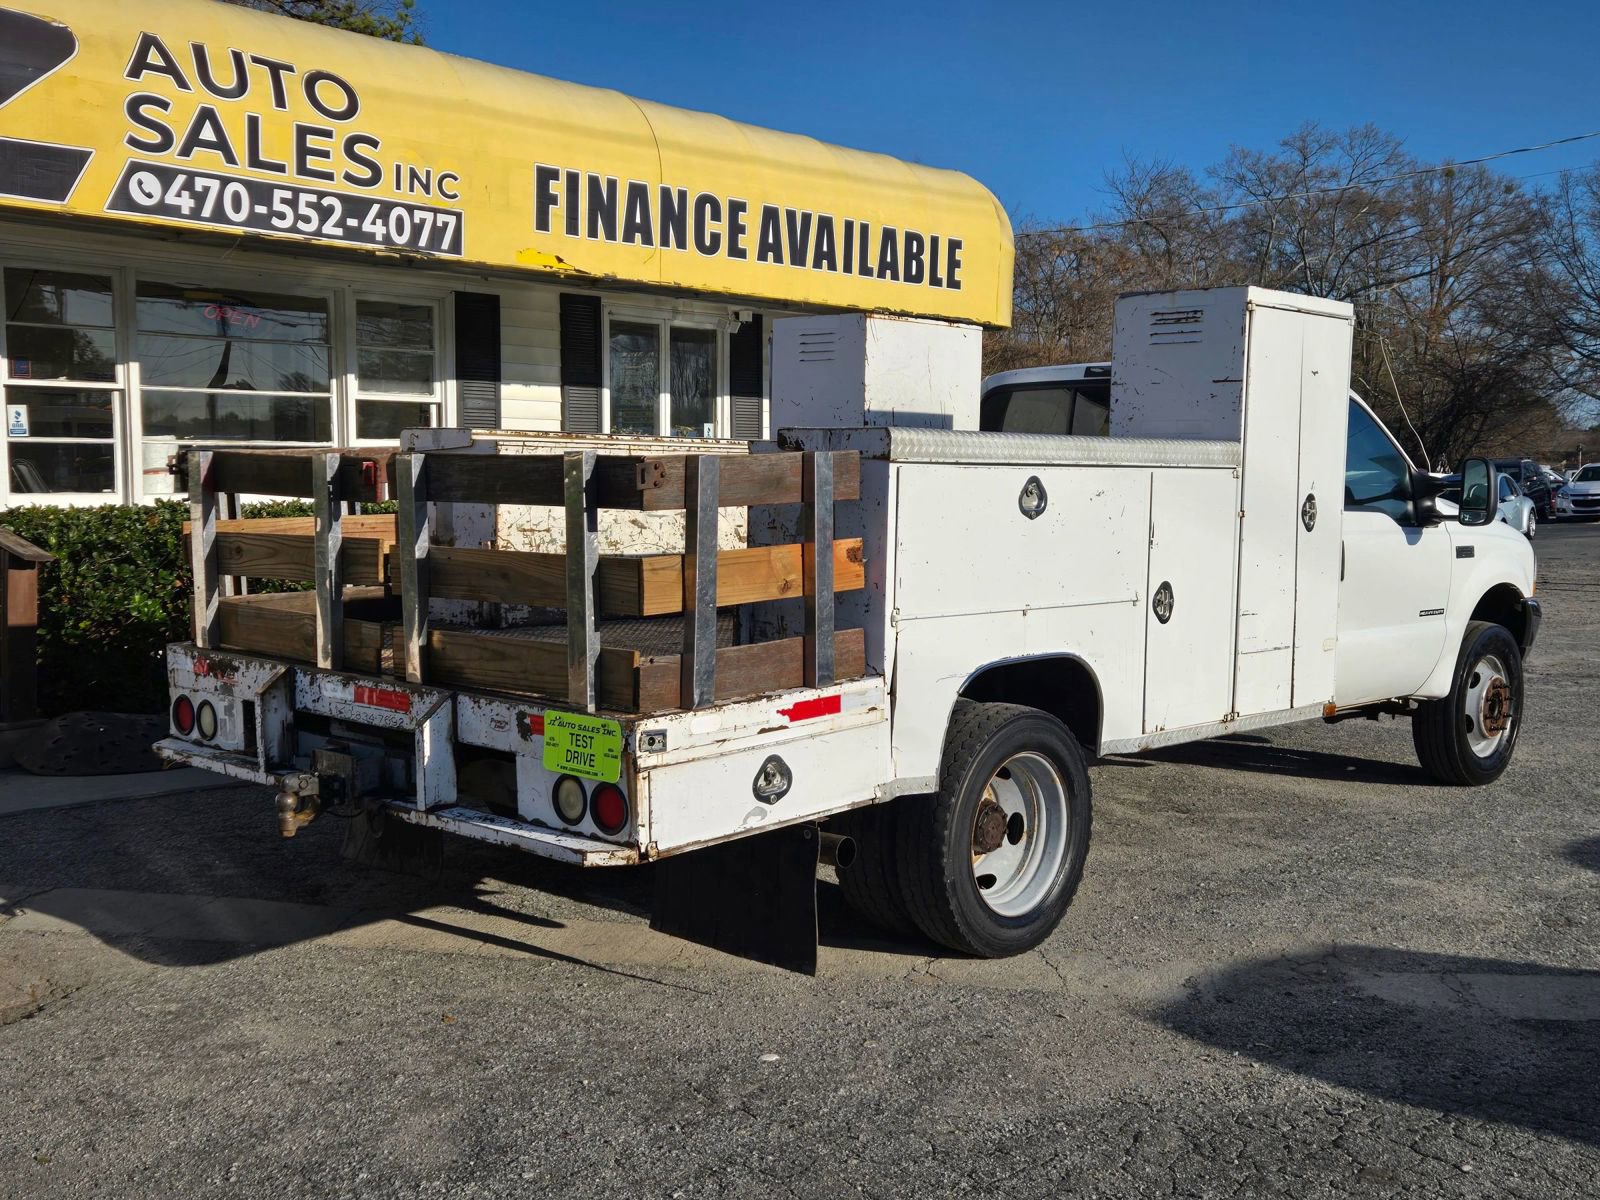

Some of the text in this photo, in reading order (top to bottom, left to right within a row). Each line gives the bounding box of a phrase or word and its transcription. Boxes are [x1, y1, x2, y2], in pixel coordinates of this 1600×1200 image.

[124, 31, 361, 123] AUTO
[124, 92, 461, 201] SALES INC
[164, 173, 458, 252] 470-552-4077
[534, 163, 964, 291] FINANCE AVAILABLE
[203, 303, 260, 329] OPEN
[558, 721, 576, 730] AUTO
[577, 724, 601, 734] SALES
[569, 732, 594, 749] TEST
[565, 749, 596, 768] DRIVE
